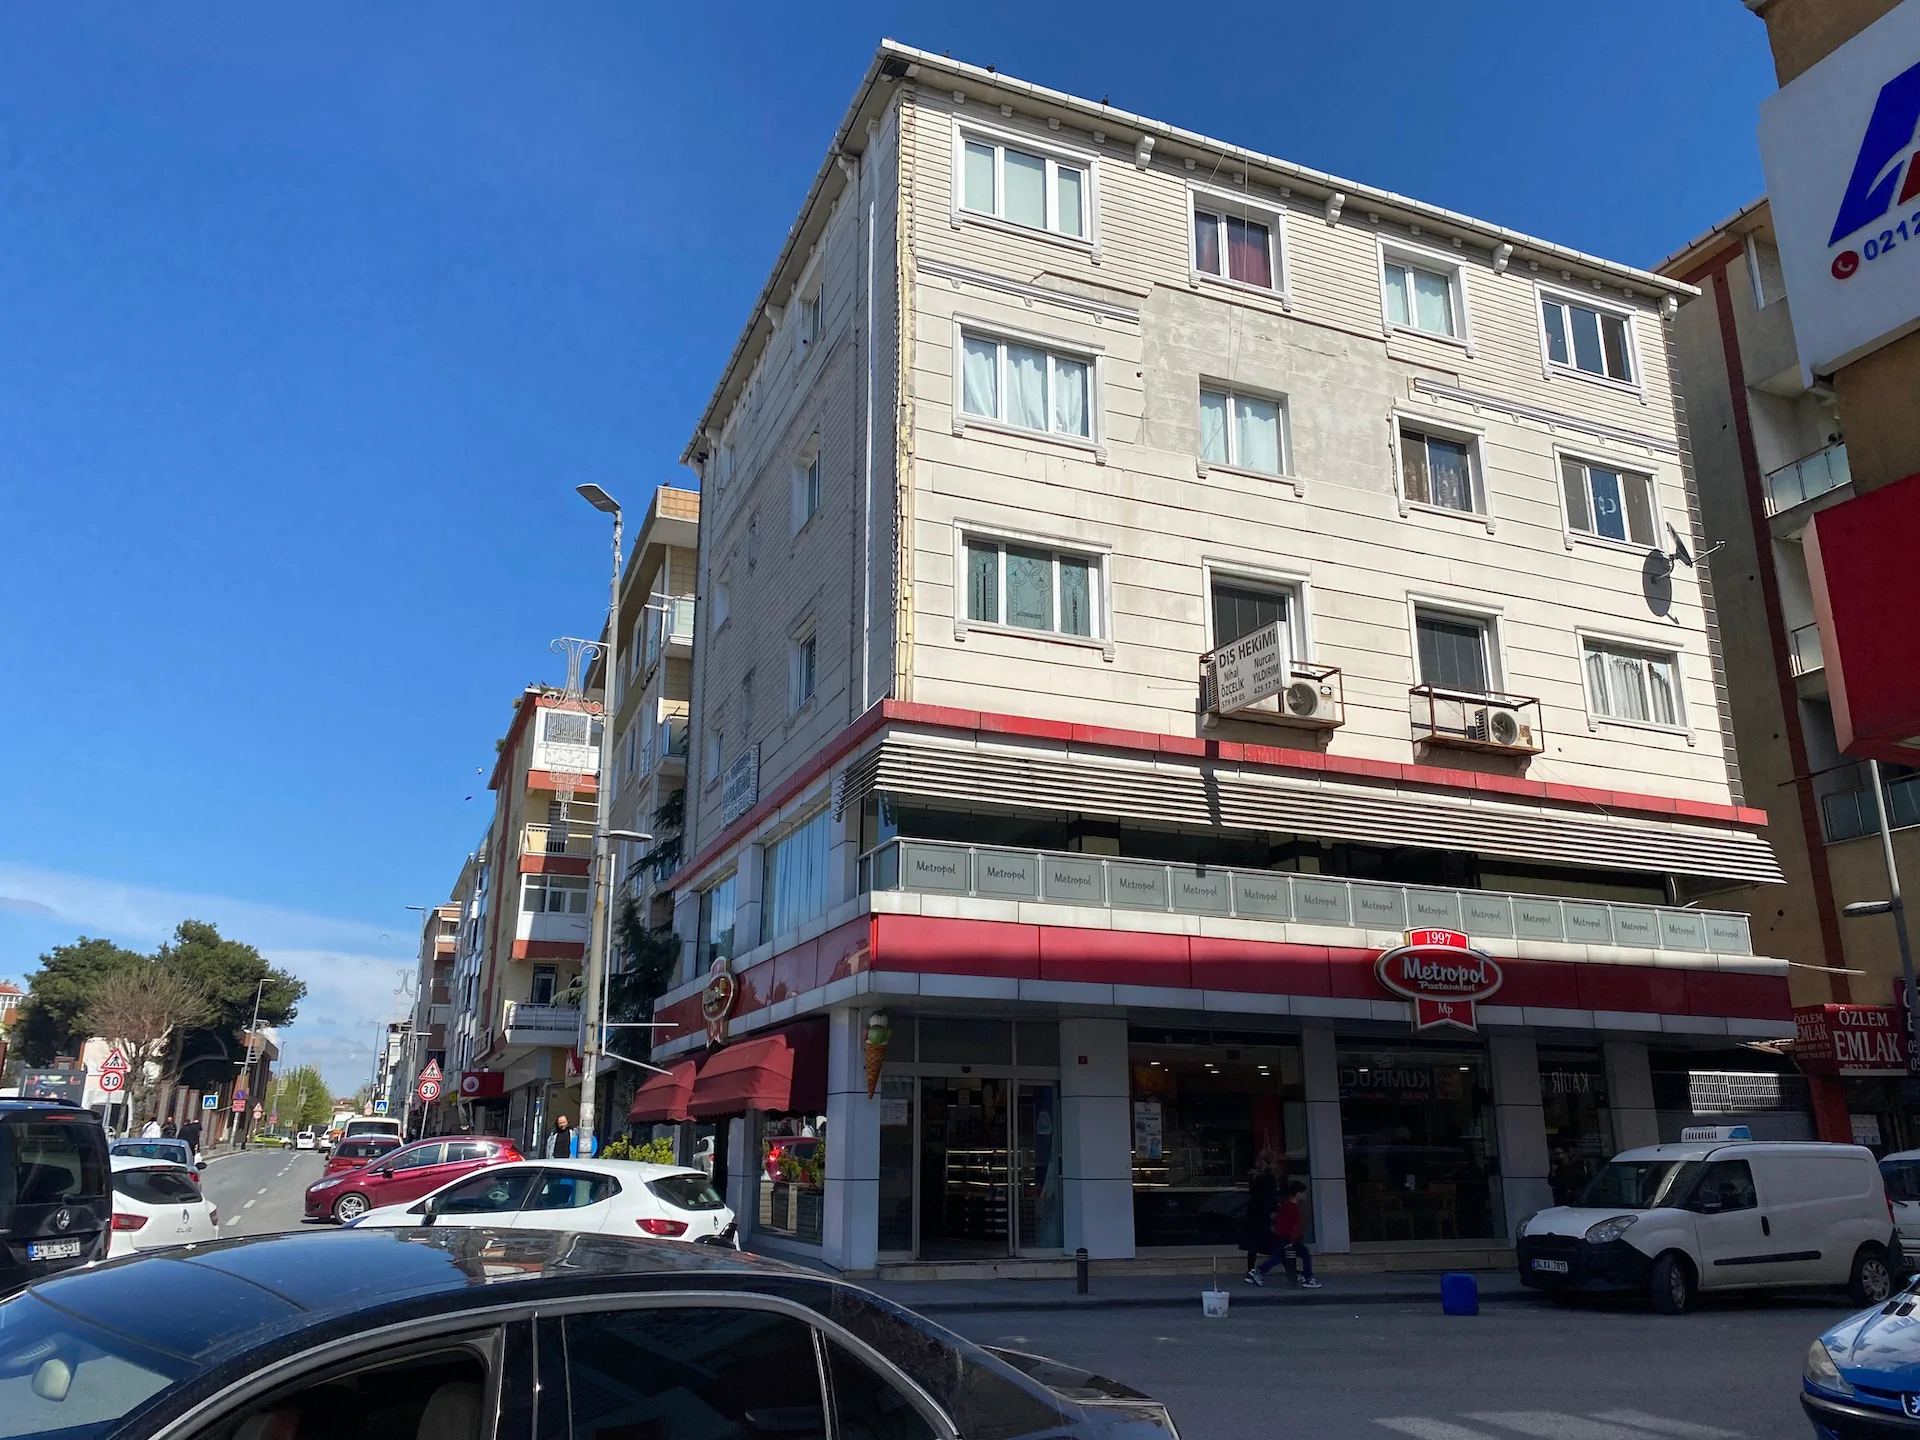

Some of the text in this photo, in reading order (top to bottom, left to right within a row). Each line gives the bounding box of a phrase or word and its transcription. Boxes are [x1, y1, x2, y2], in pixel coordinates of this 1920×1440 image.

[1219, 628, 1276, 668] DİŞ HEKİMİ
[1254, 652, 1276, 668] Nurcan
[915, 860, 956, 876] Metropol
[987, 866, 1026, 882] Metropol
[1054, 872, 1092, 887] Metropol
[1120, 878, 1155, 893] Metropol
[1183, 884, 1217, 900] Metropol
[1244, 889, 1278, 904] Metropol
[1304, 894, 1337, 909] Metropol
[1362, 899, 1394, 913] Metropol
[1417, 904, 1449, 918] Metropol
[1471, 909, 1502, 922] Metropol
[1523, 913, 1551, 926] Metropol
[1573, 917, 1602, 929] Metropol
[1621, 920, 1650, 932] Metropol
[1669, 924, 1696, 936] Metropol
[1713, 928, 1740, 939] Metropol
[1425, 931, 1452, 945] 1997
[1402, 956, 1489, 985] Metropol
[1438, 1002, 1453, 1018] Mp
[1839, 1006, 1889, 1027] ÖZLEM
[1794, 1013, 1824, 1025] ÖZLEM
[1832, 1030, 1903, 1061] EMLAK
[103, 1076, 119, 1087] 30
[422, 1084, 435, 1095] 30
